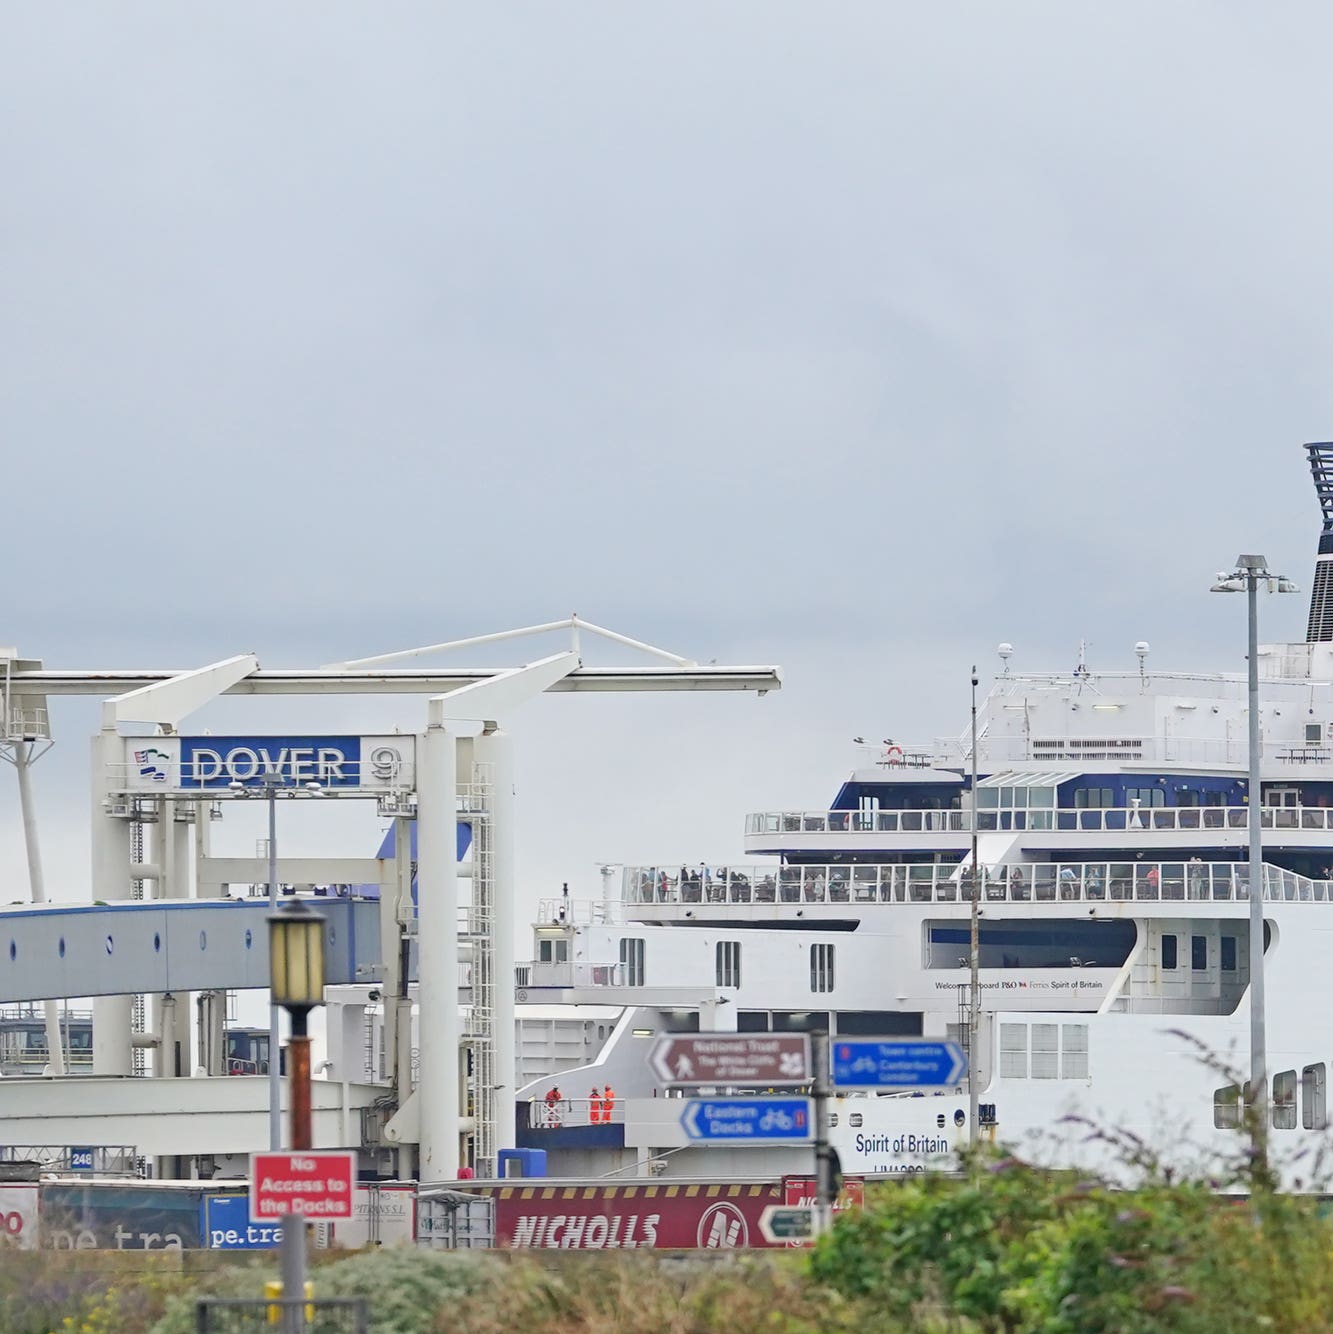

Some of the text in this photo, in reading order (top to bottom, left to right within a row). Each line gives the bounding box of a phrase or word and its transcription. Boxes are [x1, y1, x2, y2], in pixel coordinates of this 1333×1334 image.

[192, 747, 402, 781] DOVER 9
[1050, 981, 1070, 989] Spirit
[1070, 981, 1078, 989] of
[1079, 981, 1103, 989] Britain
[693, 1040, 779, 1053] National Trust
[704, 1105, 758, 1119] Eastern
[710, 1120, 753, 1135] Docks
[856, 1133, 948, 1156] Spirit of Britain
[72, 1153, 92, 1165] 248
[290, 1158, 315, 1172] No
[260, 1178, 346, 1193] Access to
[260, 1197, 347, 1214] the Docks
[798, 1197, 854, 1210] NICLLS
[511, 1215, 660, 1248] NICHOLLS
